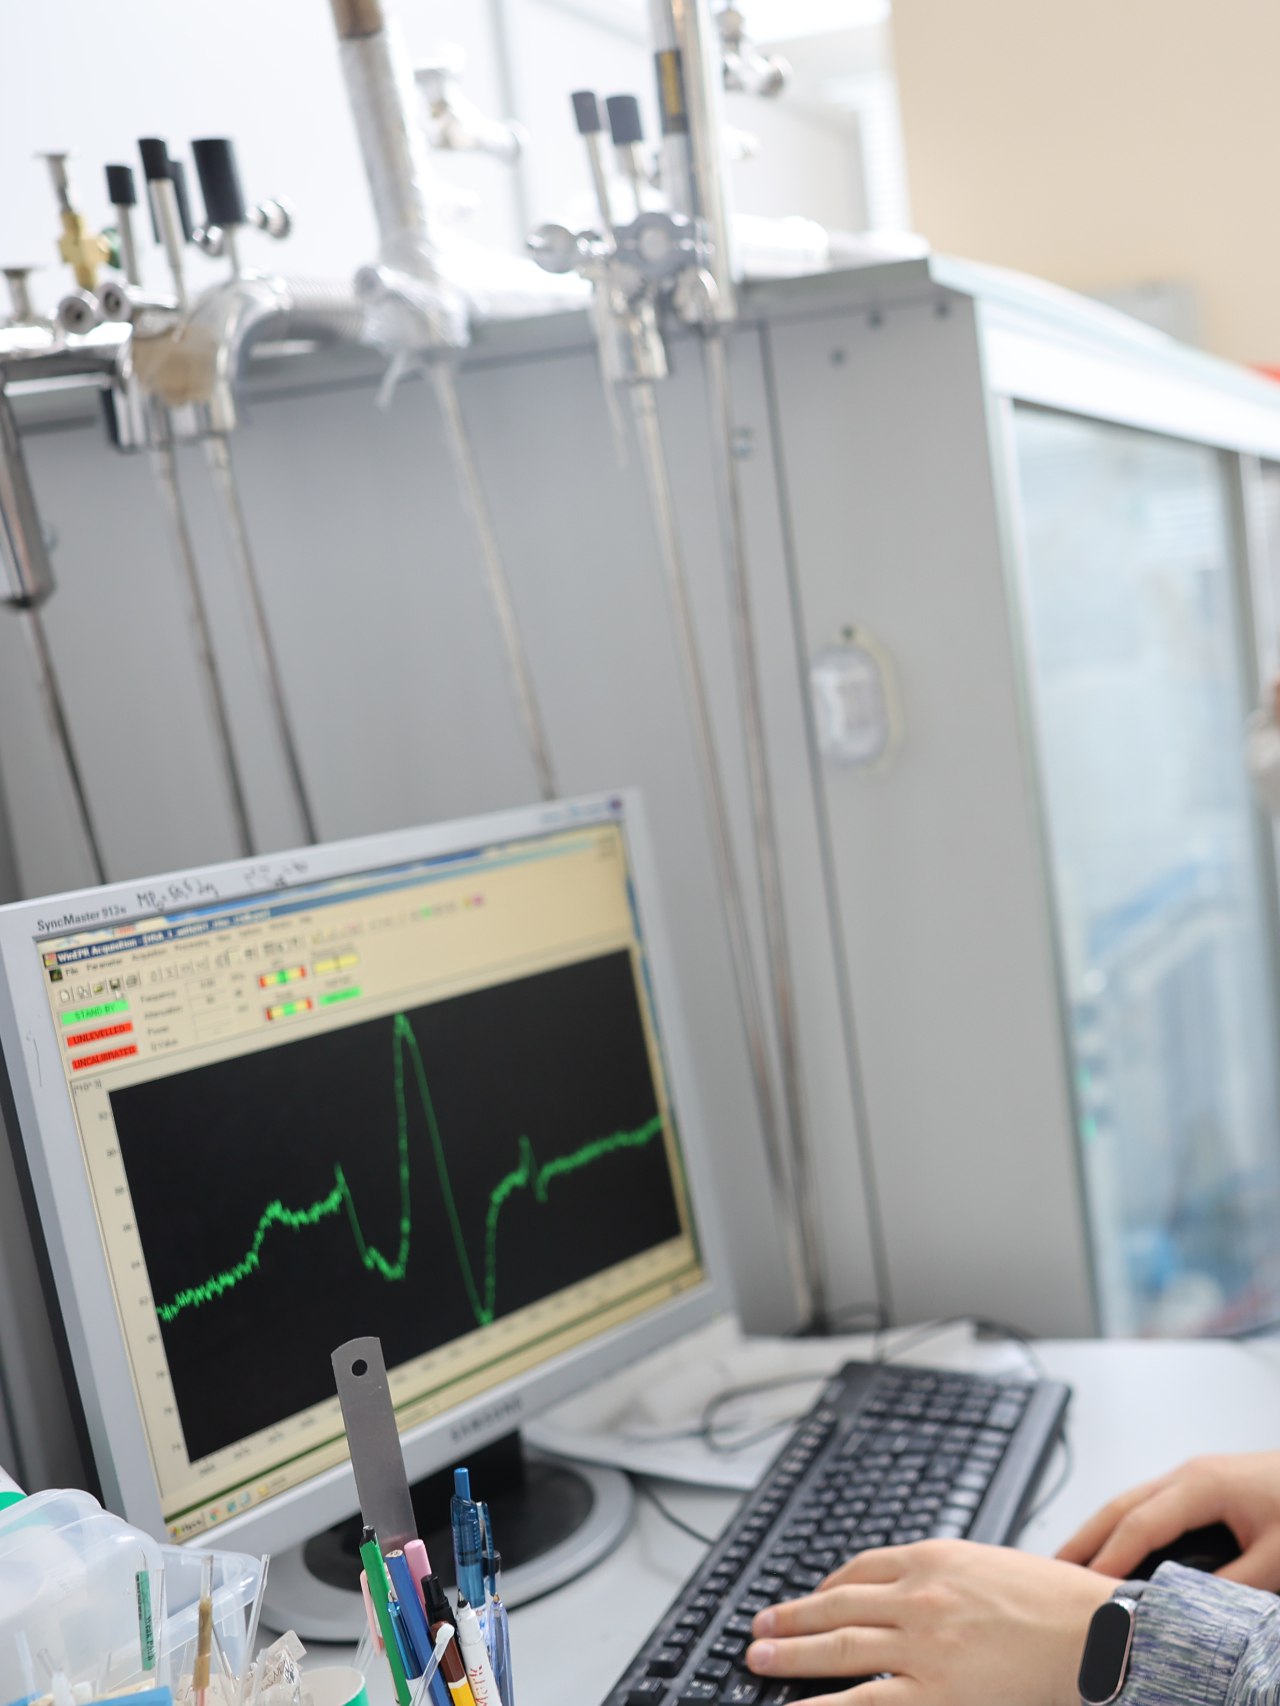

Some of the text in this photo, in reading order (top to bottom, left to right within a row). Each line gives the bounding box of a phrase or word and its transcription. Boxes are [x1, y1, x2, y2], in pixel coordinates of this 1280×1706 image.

[37, 912, 99, 932] SyncMaster
[75, 1008, 102, 1020] STAND
[73, 1023, 126, 1045] UNLEVELLED
[73, 1046, 137, 1070] UNCALIBRATED
